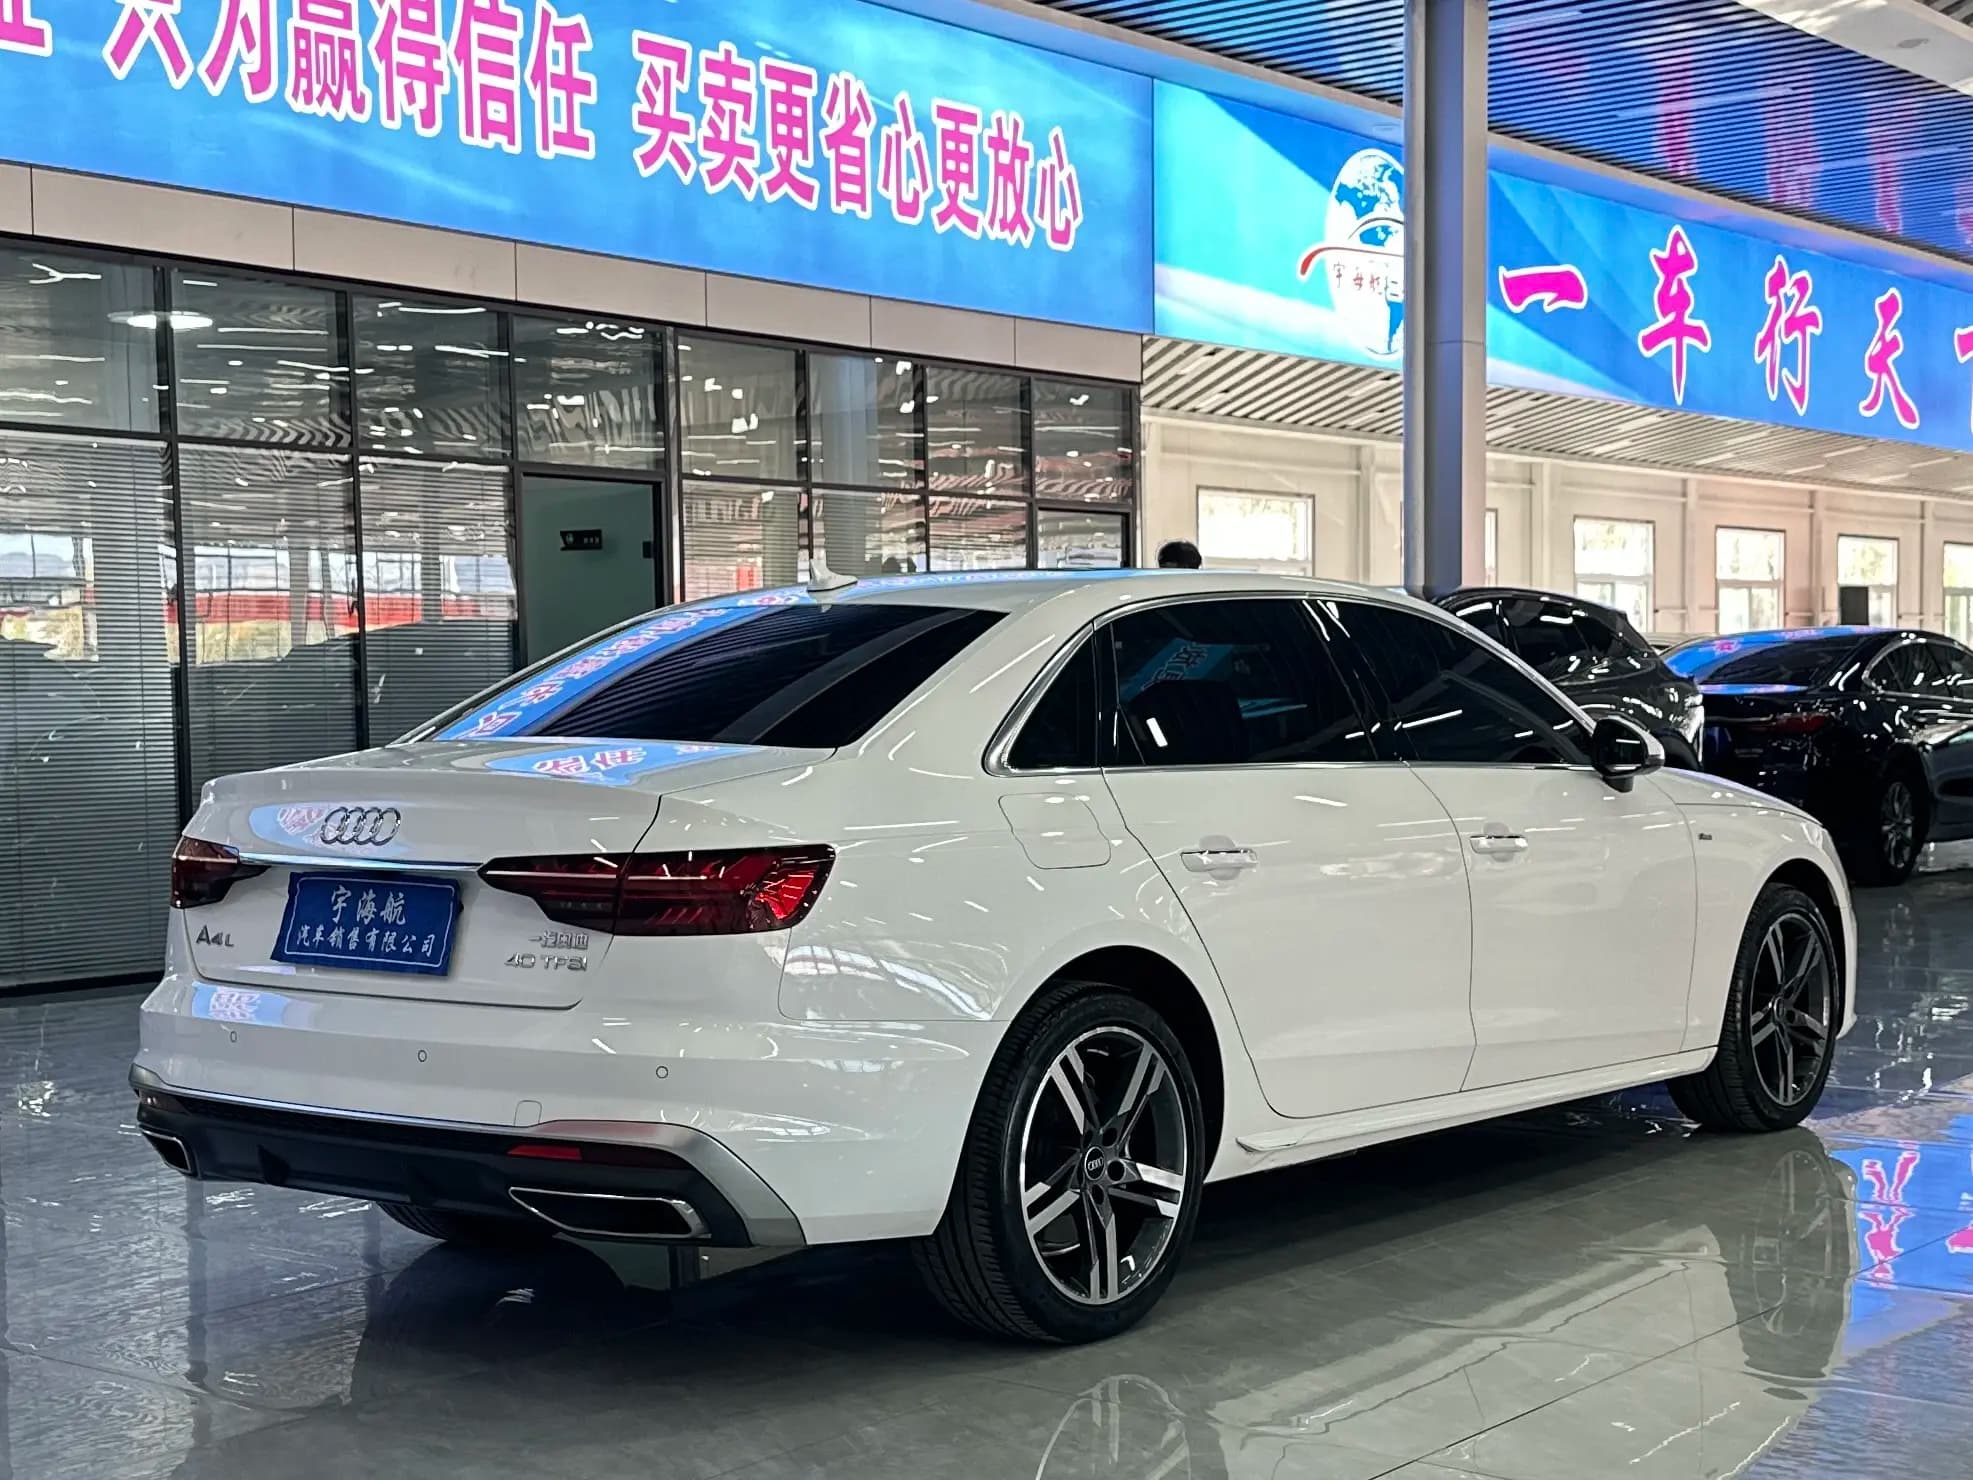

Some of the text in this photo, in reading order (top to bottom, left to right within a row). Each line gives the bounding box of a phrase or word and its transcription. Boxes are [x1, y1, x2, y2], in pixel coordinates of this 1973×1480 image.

[633, 32, 1081, 249] 买卖更省心更放心
[1499, 227, 1973, 431] 一车行天
[331, 884, 407, 925] 宇海航
[196, 925, 234, 947] A4L
[297, 923, 436, 957] 汽车销售有限公司
[504, 953, 588, 972] 40 TFSI
